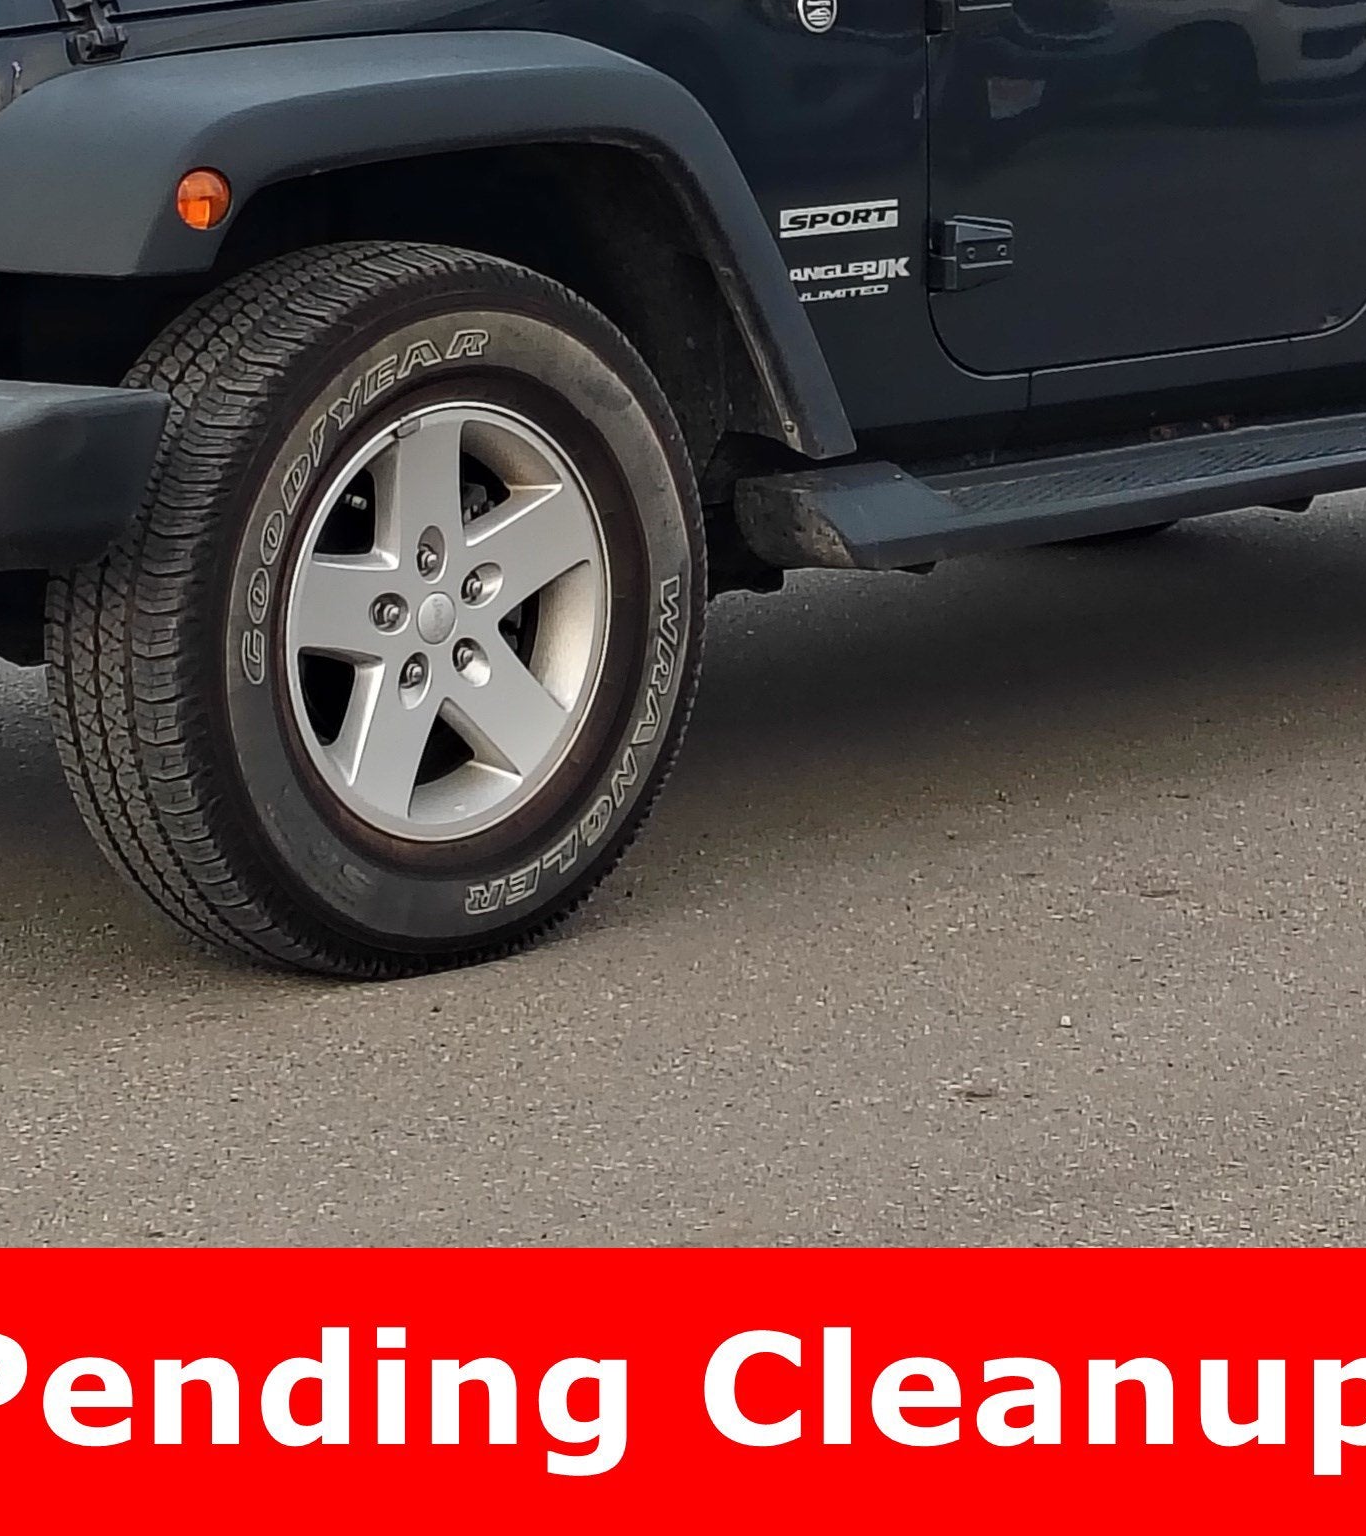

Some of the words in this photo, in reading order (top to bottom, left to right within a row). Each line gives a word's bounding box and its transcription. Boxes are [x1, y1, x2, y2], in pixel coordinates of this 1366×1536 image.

[781, 206, 898, 233] SPORT
[789, 261, 877, 282] ANGLER
[242, 329, 489, 685] GOODYEAR
[465, 575, 681, 914] WRANGLER
